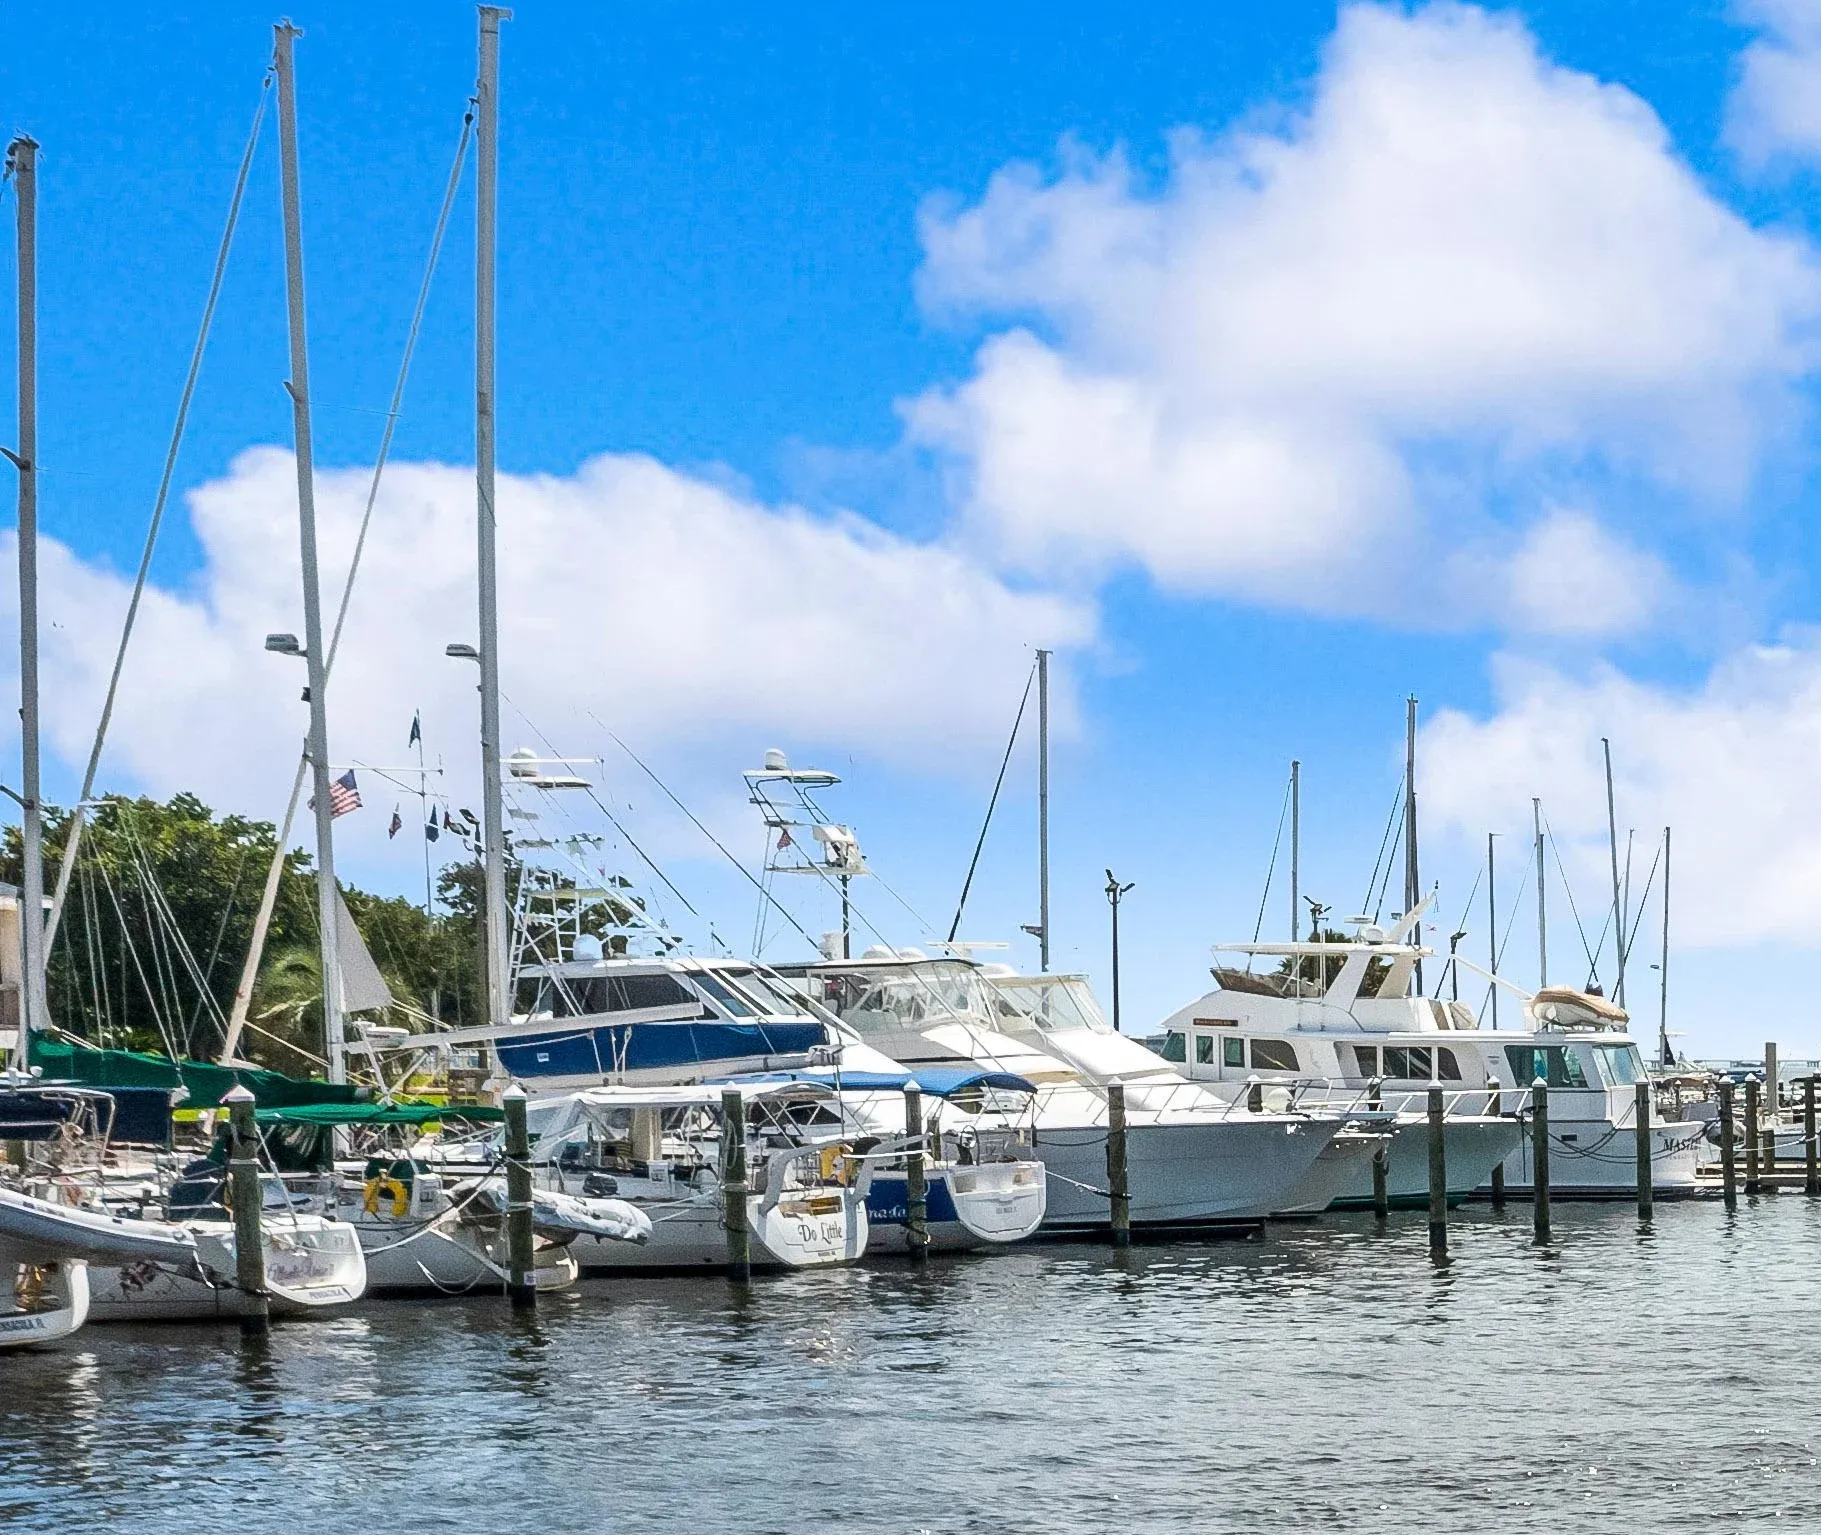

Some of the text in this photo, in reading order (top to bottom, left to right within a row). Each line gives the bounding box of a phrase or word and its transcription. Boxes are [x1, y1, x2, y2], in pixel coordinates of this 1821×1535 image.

[868, 1205, 907, 1219] nada
[798, 1221, 842, 1244] Do Little
